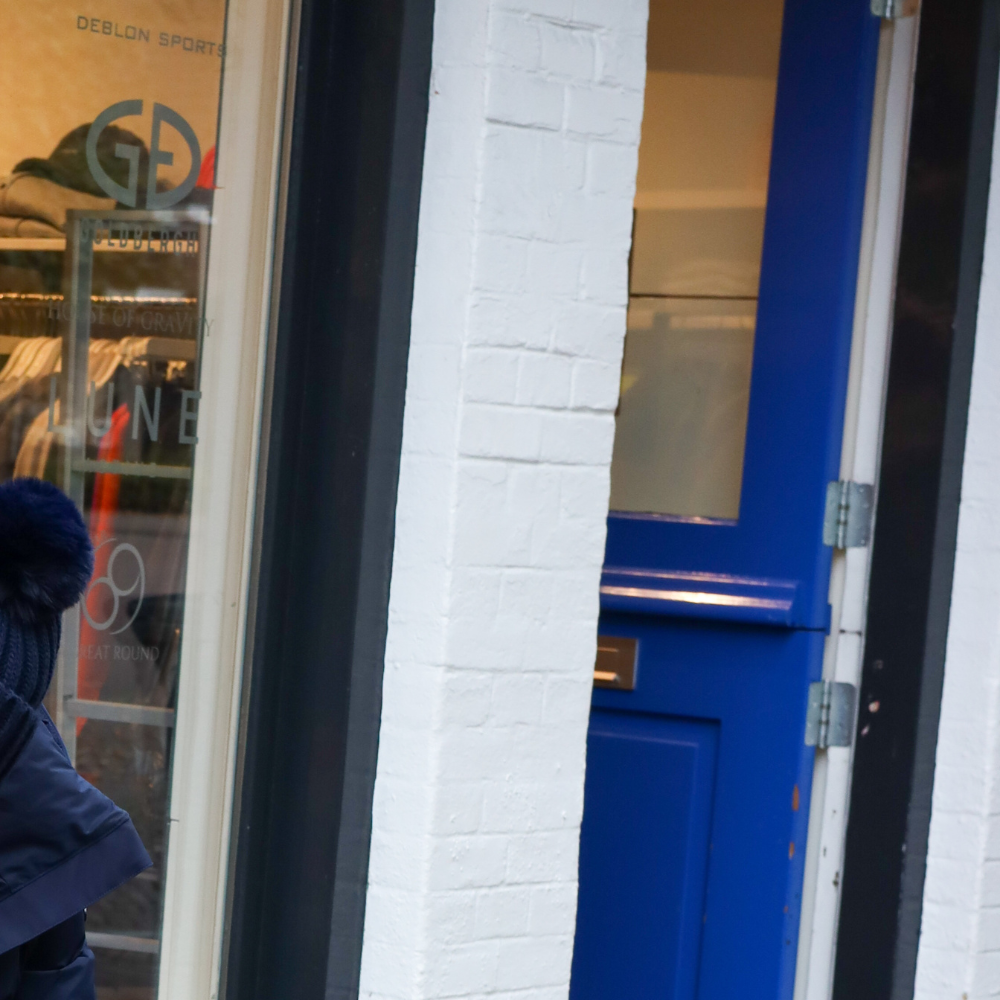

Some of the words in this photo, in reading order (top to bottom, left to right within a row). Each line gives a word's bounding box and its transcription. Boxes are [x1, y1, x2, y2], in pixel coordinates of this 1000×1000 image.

[77, 16, 150, 42] DEBLON
[159, 32, 226, 57] SPORTS
[80, 217, 197, 255] GOLDBERGH
[48, 299, 107, 325] HOSE
[112, 306, 135, 327] OF
[141, 311, 215, 337] GRAVIY
[47, 376, 202, 444] LUNE
[113, 645, 160, 661] ROUND
